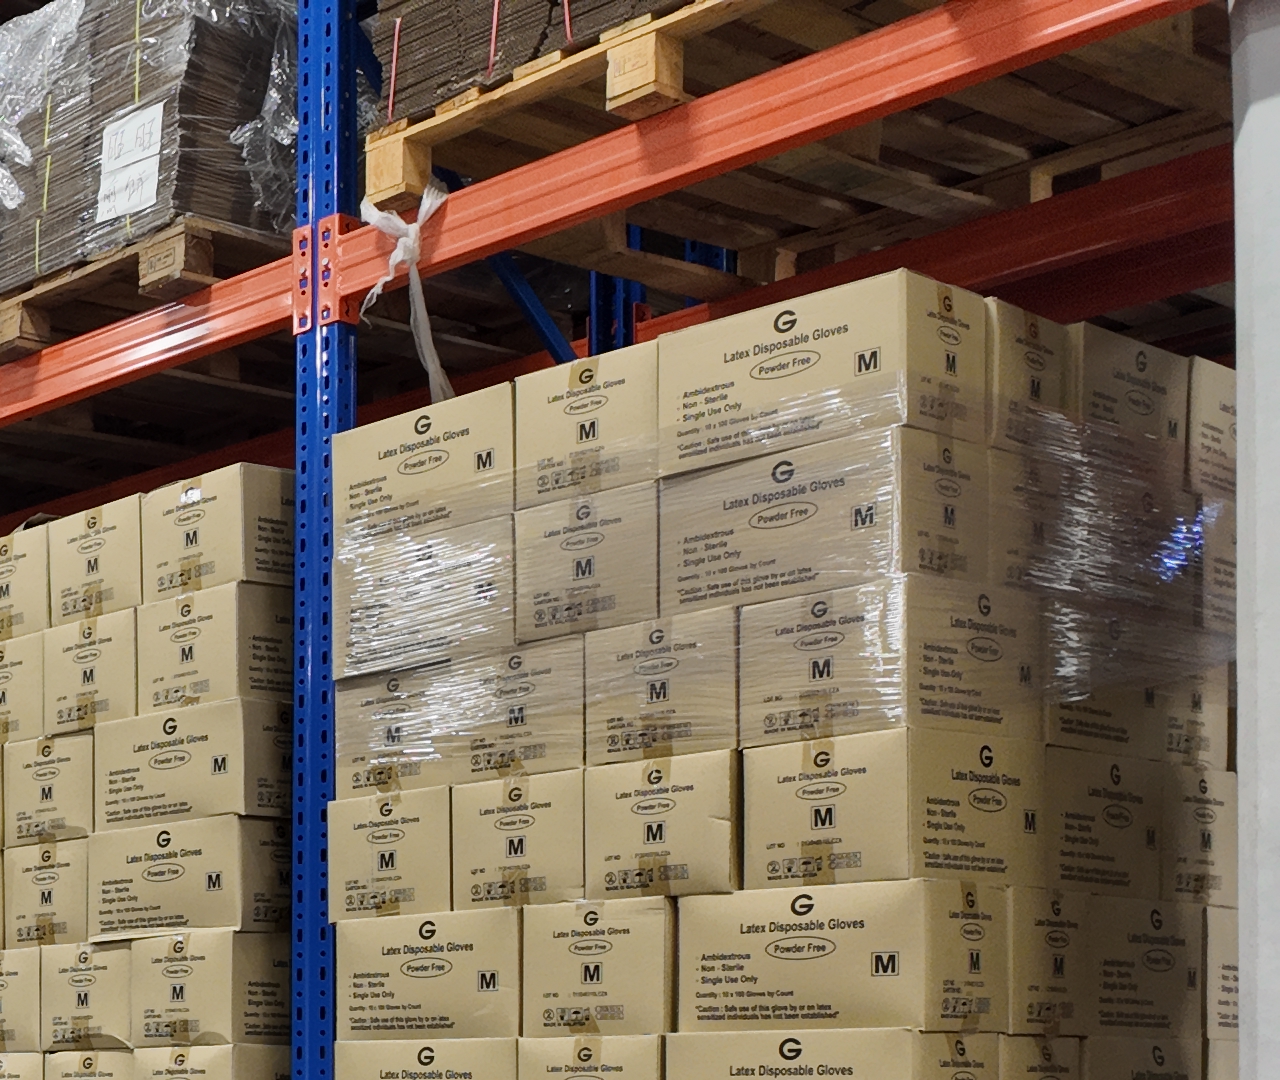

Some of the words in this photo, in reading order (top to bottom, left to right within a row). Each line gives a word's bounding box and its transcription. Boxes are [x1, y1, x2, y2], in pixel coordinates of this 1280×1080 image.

[774, 310, 797, 333] G
[724, 348, 750, 363] Latex
[753, 334, 809, 355] Disposable
[812, 324, 849, 340] Gloves
[759, 362, 789, 375] Powder
[792, 356, 811, 367] Free
[858, 351, 877, 372] M
[682, 381, 735, 399] Ambidextrous
[683, 401, 697, 410] Non
[704, 393, 728, 404] Sterile
[682, 411, 705, 422] Single
[708, 407, 721, 416] Use
[724, 402, 742, 413] Only
[771, 461, 795, 483] G
[723, 497, 749, 511] Latex
[752, 486, 807, 504] Disposable
[810, 477, 845, 492] Gloves
[758, 511, 788, 524] Powder
[790, 507, 808, 518] Free
[854, 506, 874, 527] M
[814, 751, 830, 768] G
[778, 776, 796, 784] Latex
[799, 770, 838, 782] Disposable
[841, 767, 866, 777] Gloves
[814, 808, 833, 827] M
[157, 831, 171, 848] G
[127, 855, 142, 864] Latex
[144, 851, 178, 862] Disposable
[180, 849, 202, 858] Gloves
[208, 874, 221, 889] M
[791, 894, 814, 916] G
[419, 921, 436, 940] G
[740, 923, 766, 934] Latex
[769, 920, 825, 934] Disposable
[828, 919, 865, 930] Gloves
[382, 946, 401, 955] Latex
[403, 944, 444, 955] Disposable
[447, 942, 473, 952] Gloves
[774, 945, 805, 953] Powder
[808, 943, 826, 952] Free
[701, 953, 751, 961] Ambidextrous
[875, 955, 895, 973] M
[407, 964, 430, 972] Powder
[431, 963, 445, 971] Free
[480, 973, 496, 989] M
[701, 976, 722, 985] Single
[741, 975, 758, 984] Only
[417, 1047, 434, 1066] G
[779, 1038, 802, 1060] G
[380, 1070, 399, 1079] Latex
[401, 1070, 443, 1080] Disposable
[445, 1070, 472, 1079] Gloves
[730, 1066, 755, 1076] Latex
[759, 1065, 813, 1078] Disposable
[816, 1065, 853, 1076] Gloves
